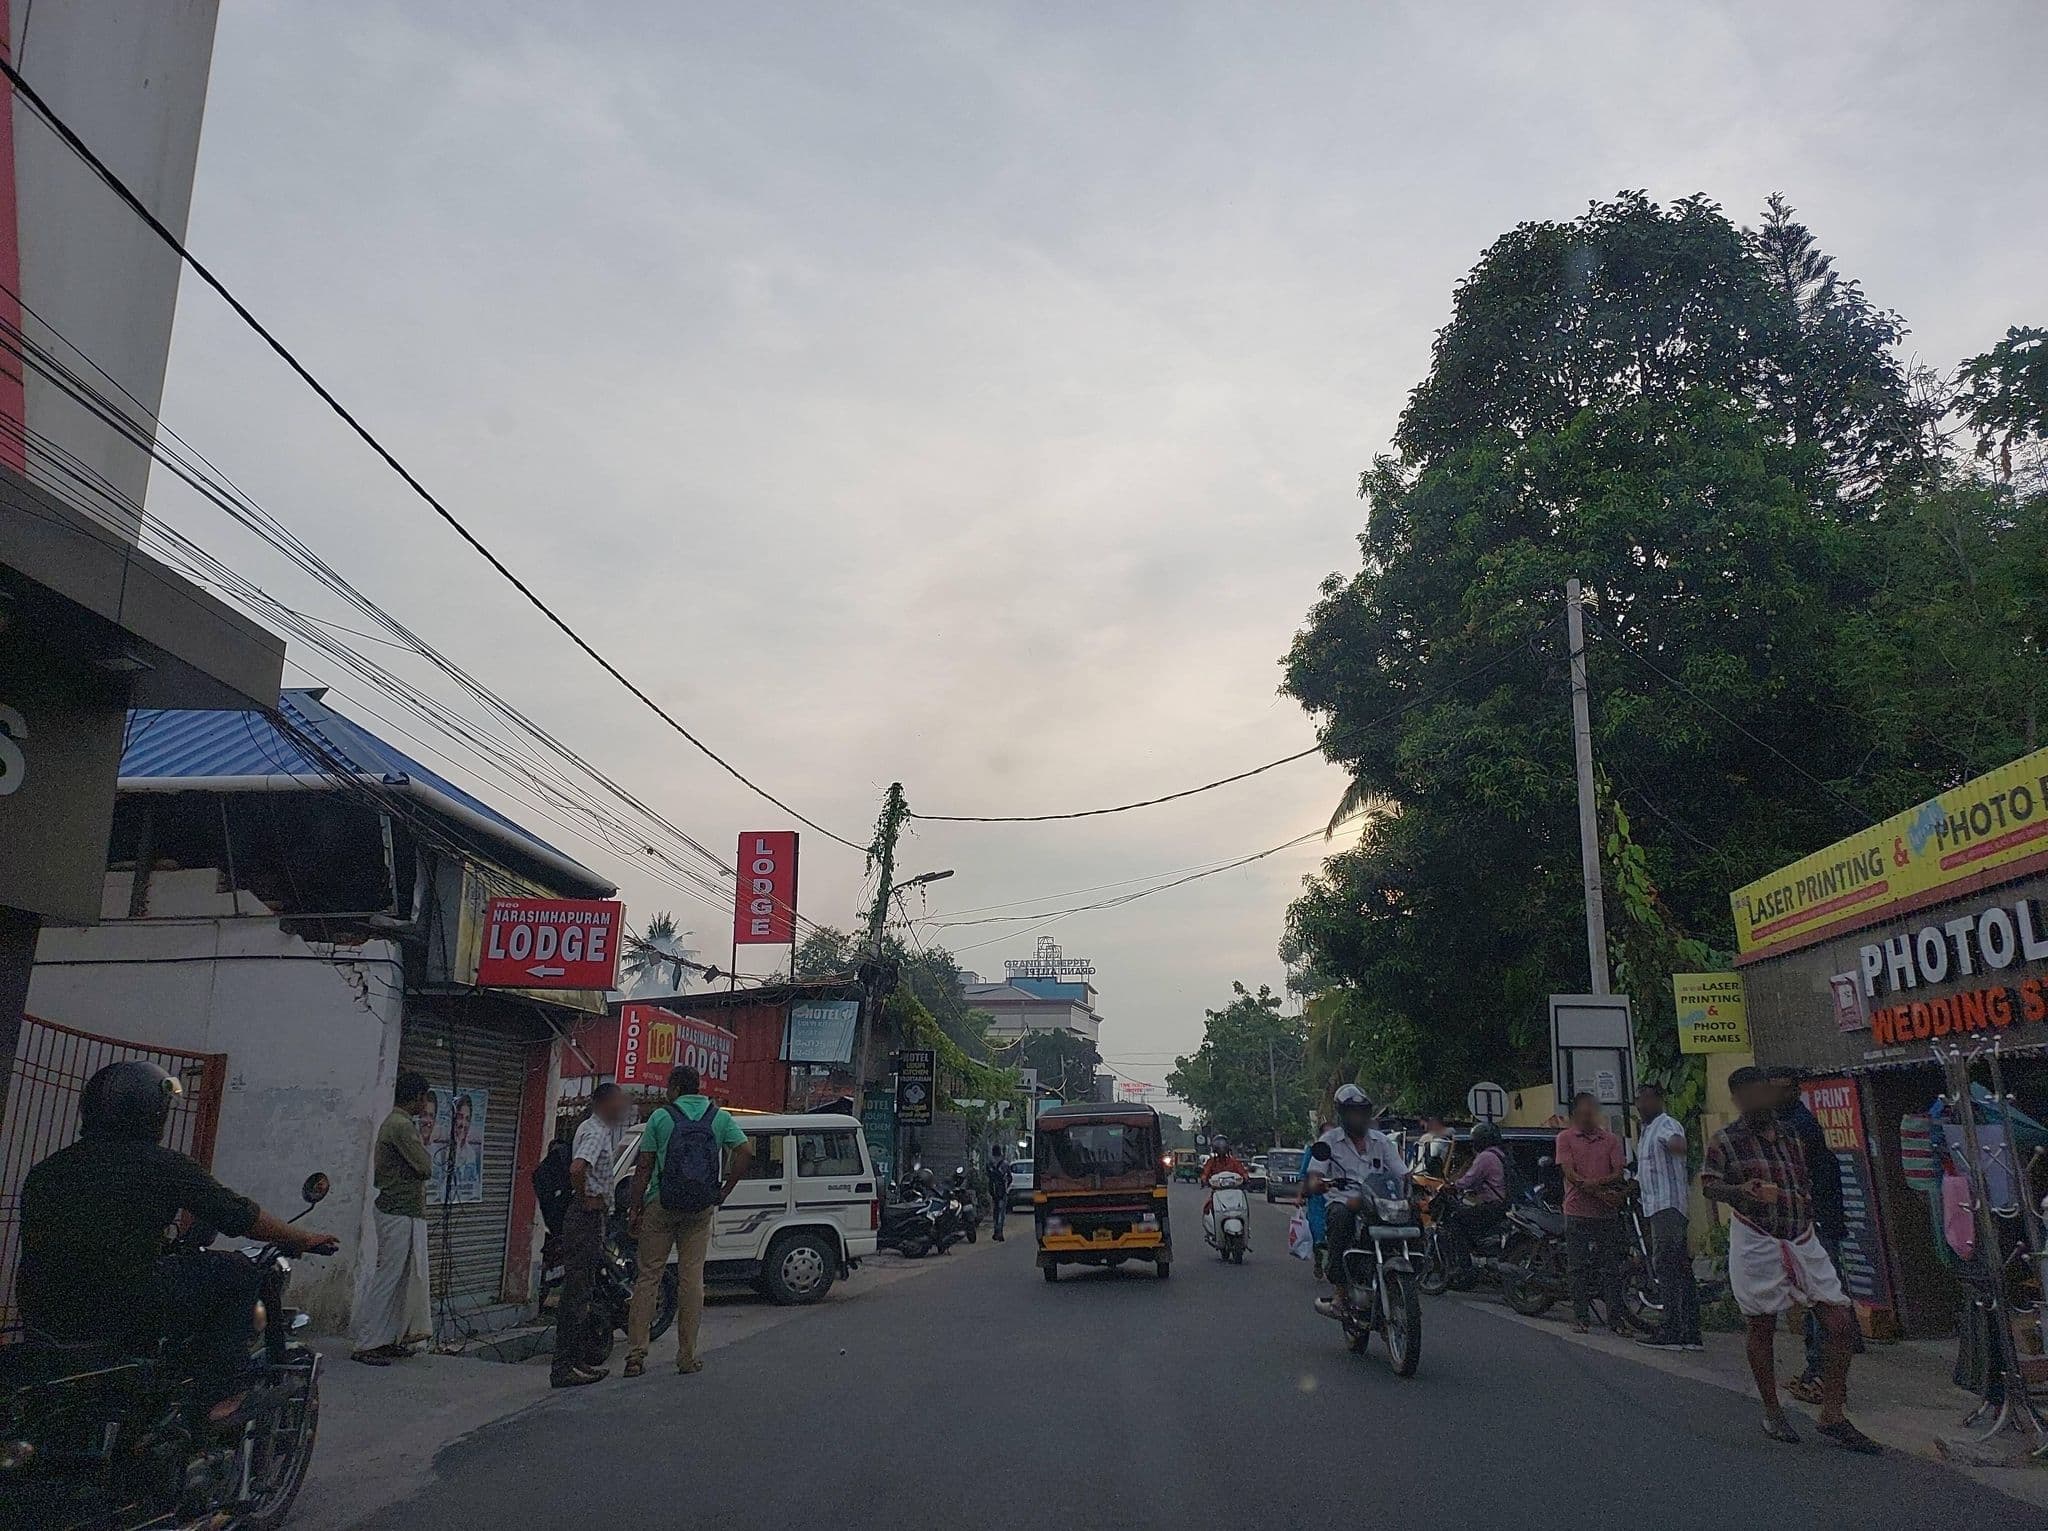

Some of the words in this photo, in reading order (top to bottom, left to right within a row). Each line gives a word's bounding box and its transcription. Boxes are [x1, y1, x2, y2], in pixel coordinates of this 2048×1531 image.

[1745, 886, 1794, 926] LASER
[1797, 846, 1885, 904] PRINTING
[1892, 837, 1911, 868] &
[1935, 784, 2034, 851] PHOTO
[750, 838, 775, 935] LODGE
[493, 910, 611, 924] NARASIMHAPURAM
[488, 924, 608, 962] LODGE
[1860, 899, 2048, 997] PHOTOL
[1702, 982, 1739, 991] LASER
[1681, 994, 1741, 1003] PRINTING
[1707, 1006, 1719, 1016] &
[1871, 986, 2012, 1043] WEDDING
[1694, 1022, 1736, 1031] PHOTO
[625, 1010, 640, 1079] LODGE
[1693, 1034, 1741, 1043] FRAMES
[674, 1041, 729, 1081] LODGE
[1814, 1087, 1850, 1108] PRINT
[1831, 1107, 1853, 1127] ANY
